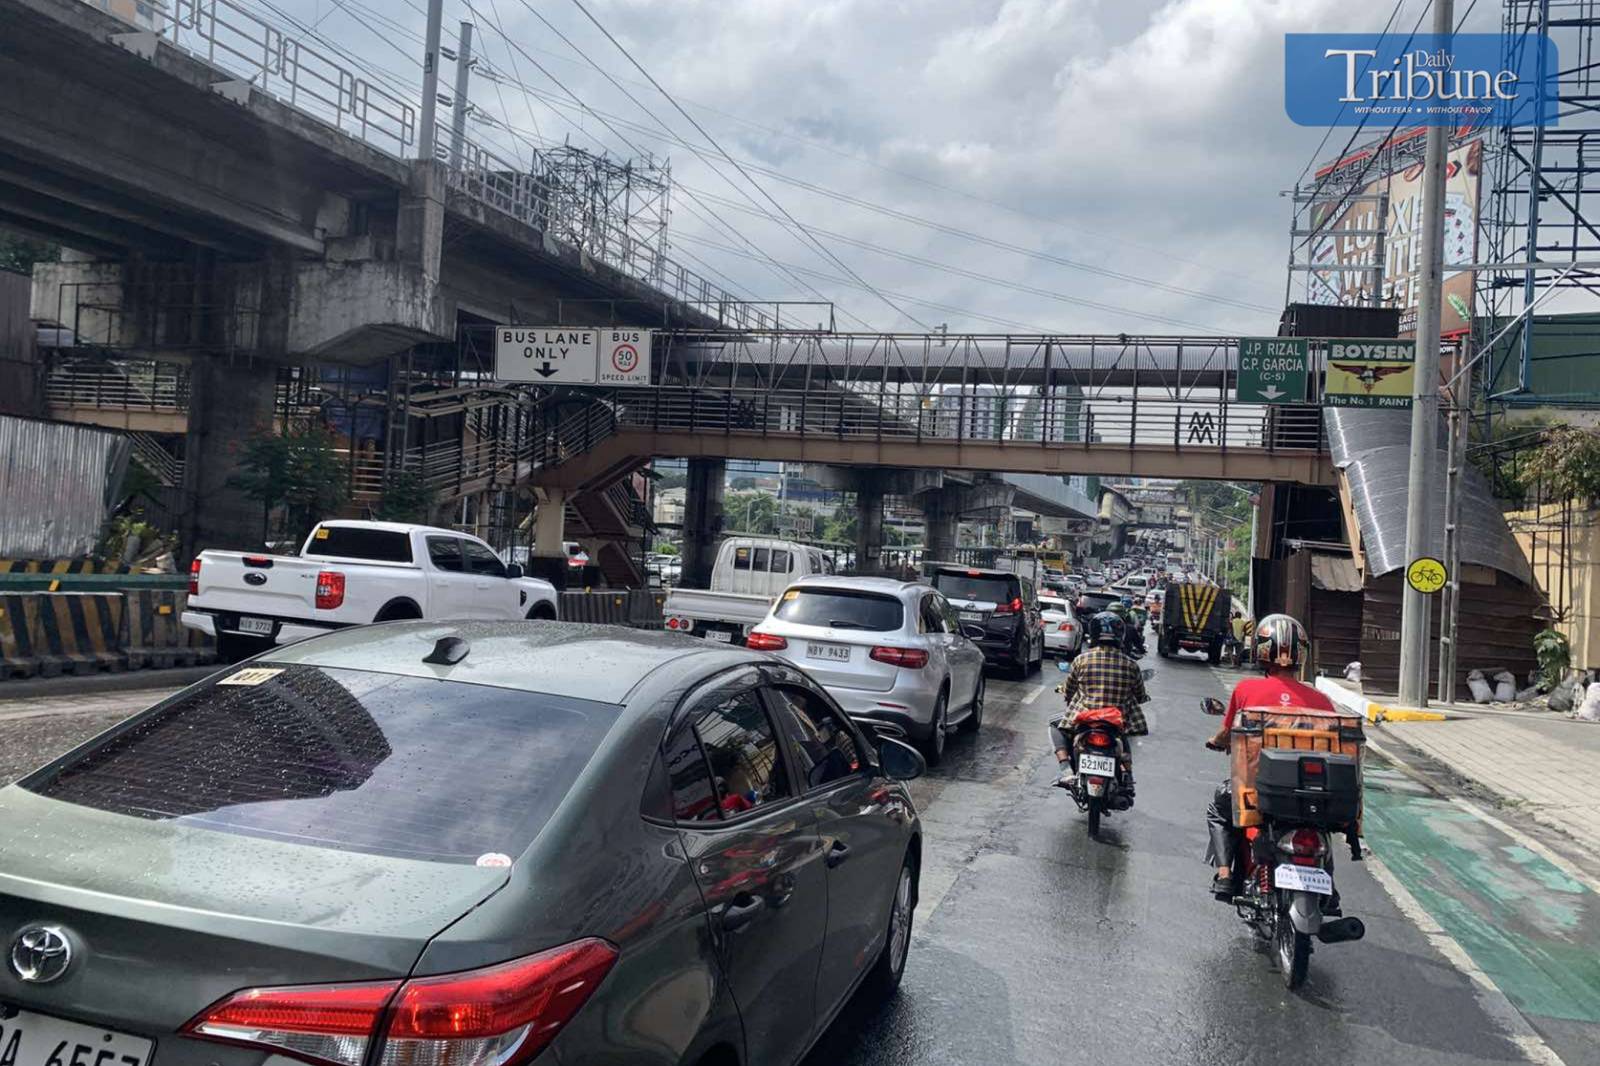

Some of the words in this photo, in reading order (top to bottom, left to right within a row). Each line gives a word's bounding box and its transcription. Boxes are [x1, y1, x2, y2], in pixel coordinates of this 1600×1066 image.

[503, 332, 536, 344] BUS
[545, 333, 591, 345] LANE
[612, 332, 639, 342] BUS
[523, 347, 569, 359] ONLY
[1245, 342, 1262, 355] J.P.
[1267, 343, 1300, 356] RIZAL
[1331, 344, 1413, 359] BOYSEN
[618, 351, 632, 361] 50
[1241, 358, 1259, 371] C.P.
[1262, 358, 1304, 372] GARCIA
[601, 373, 624, 381] SPEED
[1329, 396, 1347, 405] The
[1350, 397, 1368, 406] No.
[1378, 398, 1410, 407] PAINT
[45, 1040, 140, 1066] 65
